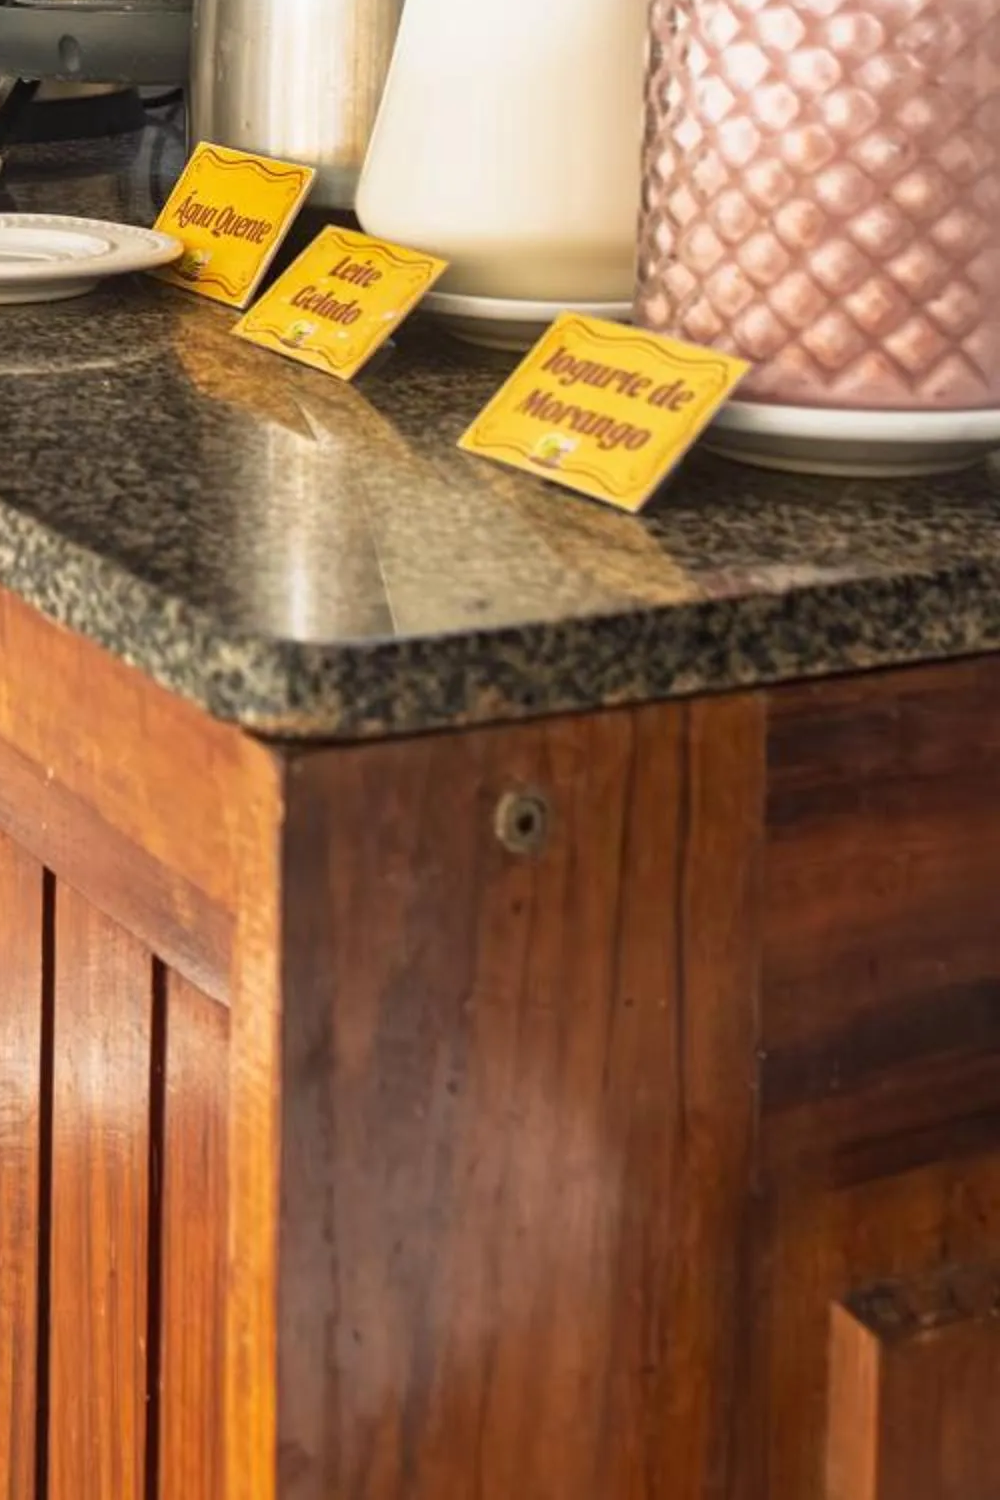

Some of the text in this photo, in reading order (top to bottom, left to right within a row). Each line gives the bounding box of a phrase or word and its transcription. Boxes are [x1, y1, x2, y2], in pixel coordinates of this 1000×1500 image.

[174, 190, 273, 245] Água Quente
[328, 255, 383, 289] Leite
[290, 285, 364, 326] Gelado
[541, 346, 695, 413] Iogurte de
[514, 388, 653, 451] Morango
